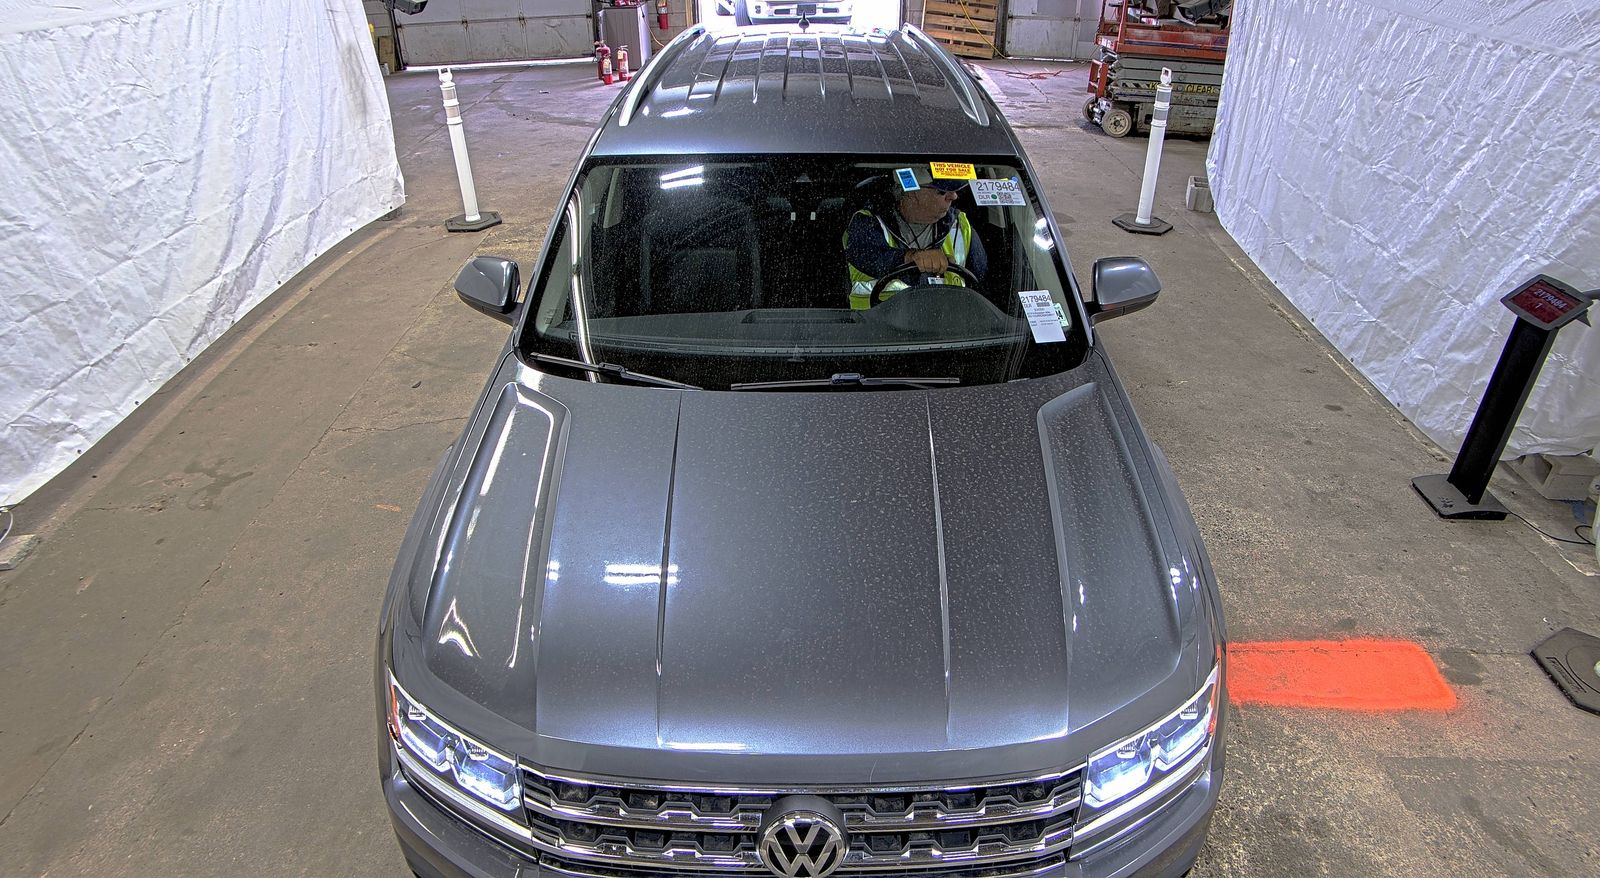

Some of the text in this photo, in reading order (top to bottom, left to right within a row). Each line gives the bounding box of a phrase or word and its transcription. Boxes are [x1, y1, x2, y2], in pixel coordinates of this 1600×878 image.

[976, 181, 1020, 191] 2179484
[1534, 288, 1568, 309] 2179484
[765, 817, 841, 878] VW
